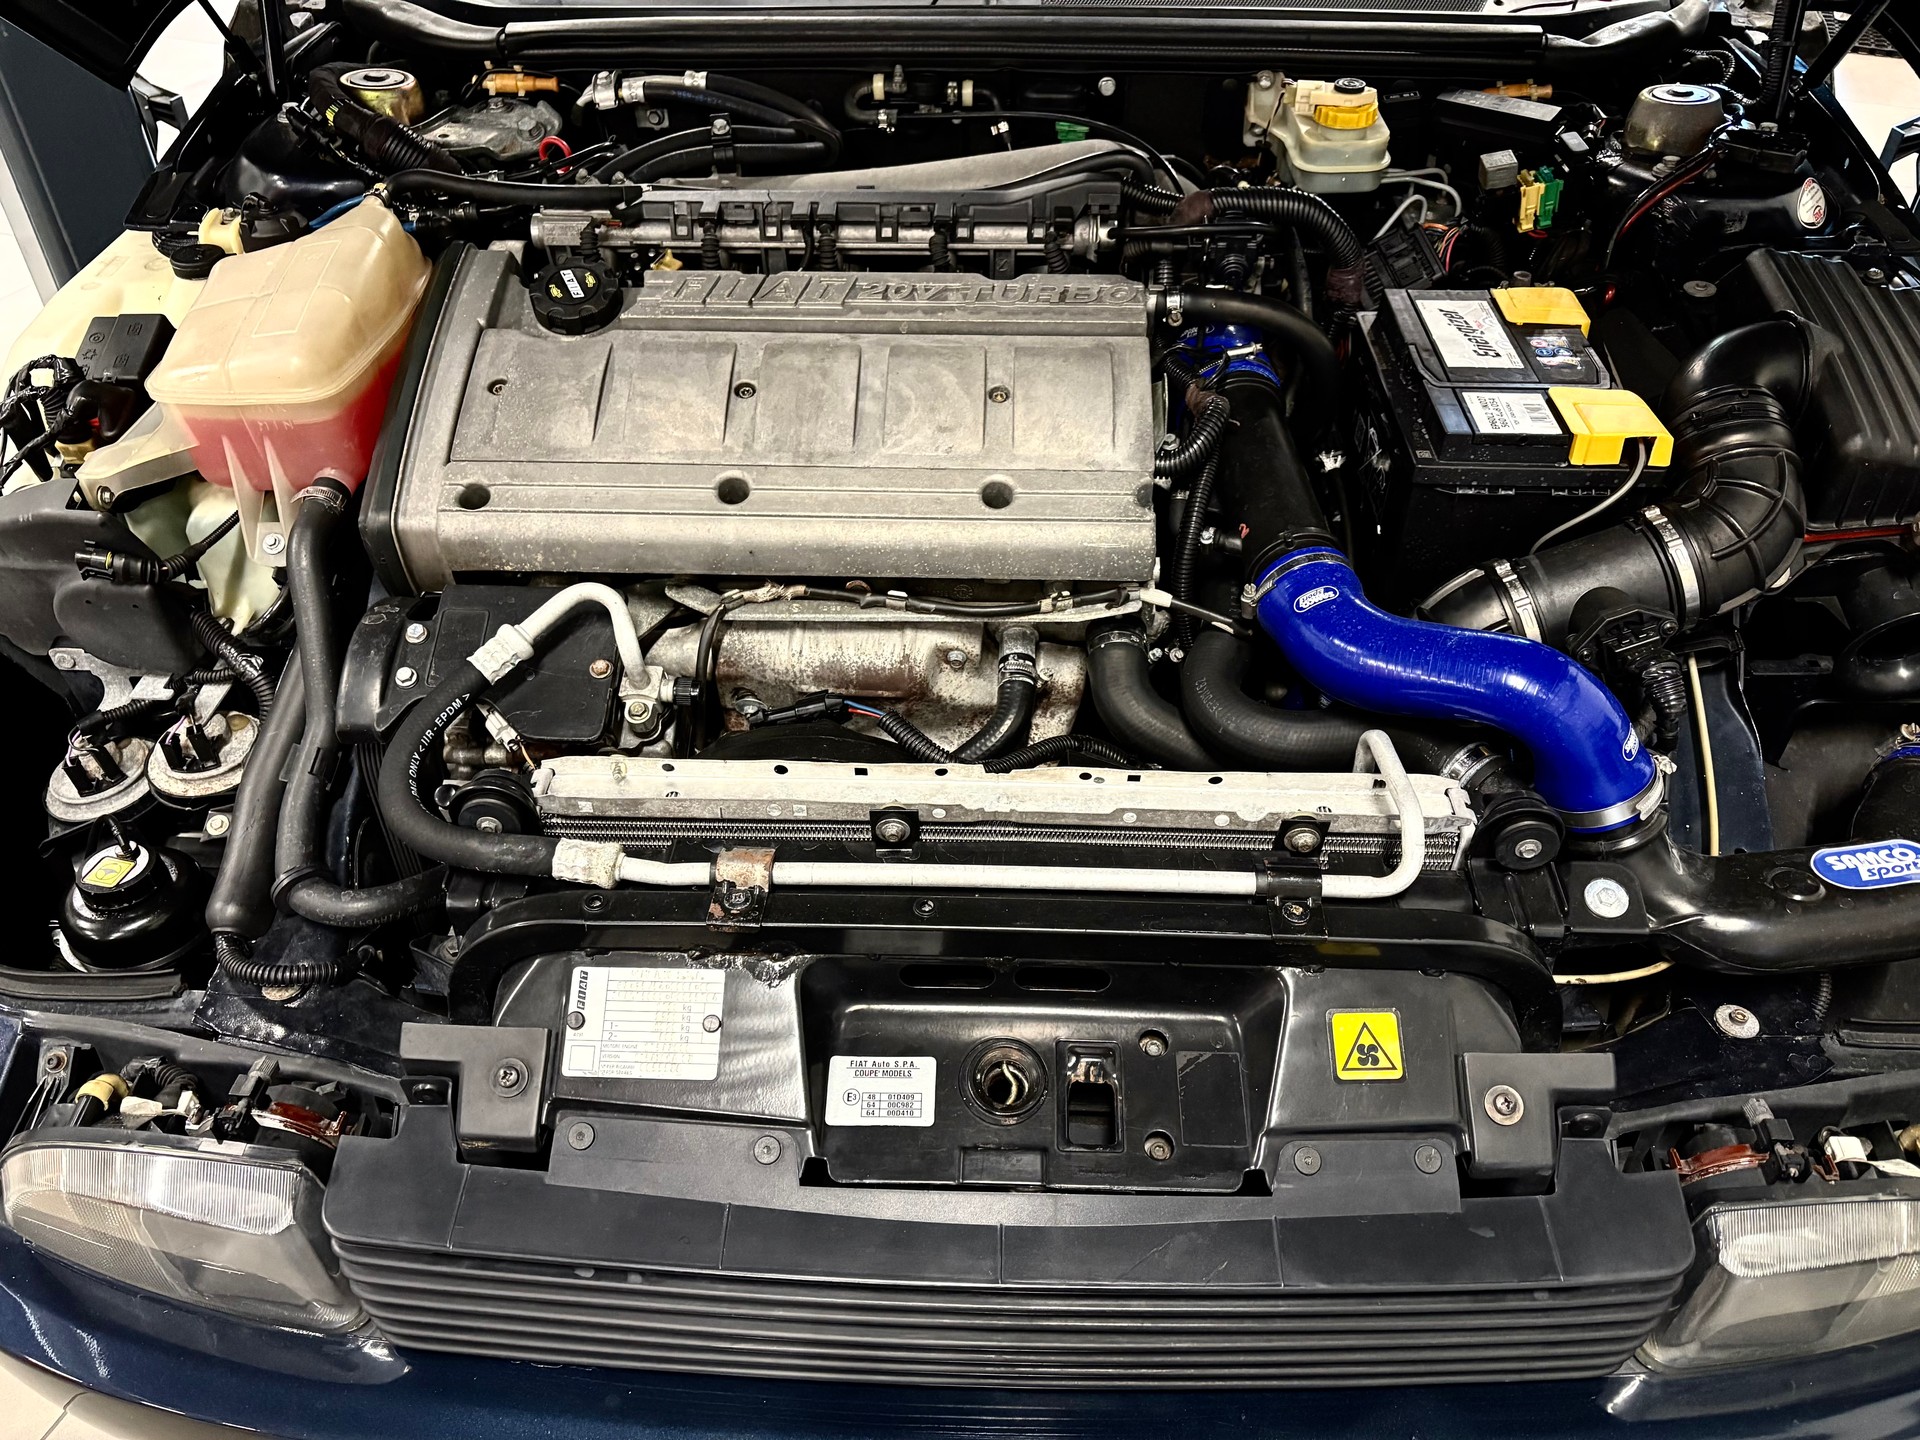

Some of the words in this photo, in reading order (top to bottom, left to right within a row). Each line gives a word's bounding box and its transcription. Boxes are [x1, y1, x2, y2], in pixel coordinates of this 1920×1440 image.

[561, 271, 583, 297] FIAT
[673, 276, 848, 300] FIAT
[858, 282, 946, 301] 20V
[965, 282, 1139, 304] TURBO
[1438, 308, 1501, 358] Energizer
[409, 752, 421, 778] ONLY
[1824, 847, 1917, 871] SAMCO
[1866, 861, 1920, 879] sport
[577, 970, 589, 1010] FIAT
[682, 1004, 692, 1012] kg
[681, 1014, 691, 1022] kg
[680, 1024, 690, 1032] kg
[679, 1034, 689, 1043] kg
[872, 1060, 890, 1068] Auto
[846, 1092, 857, 1102] E3
